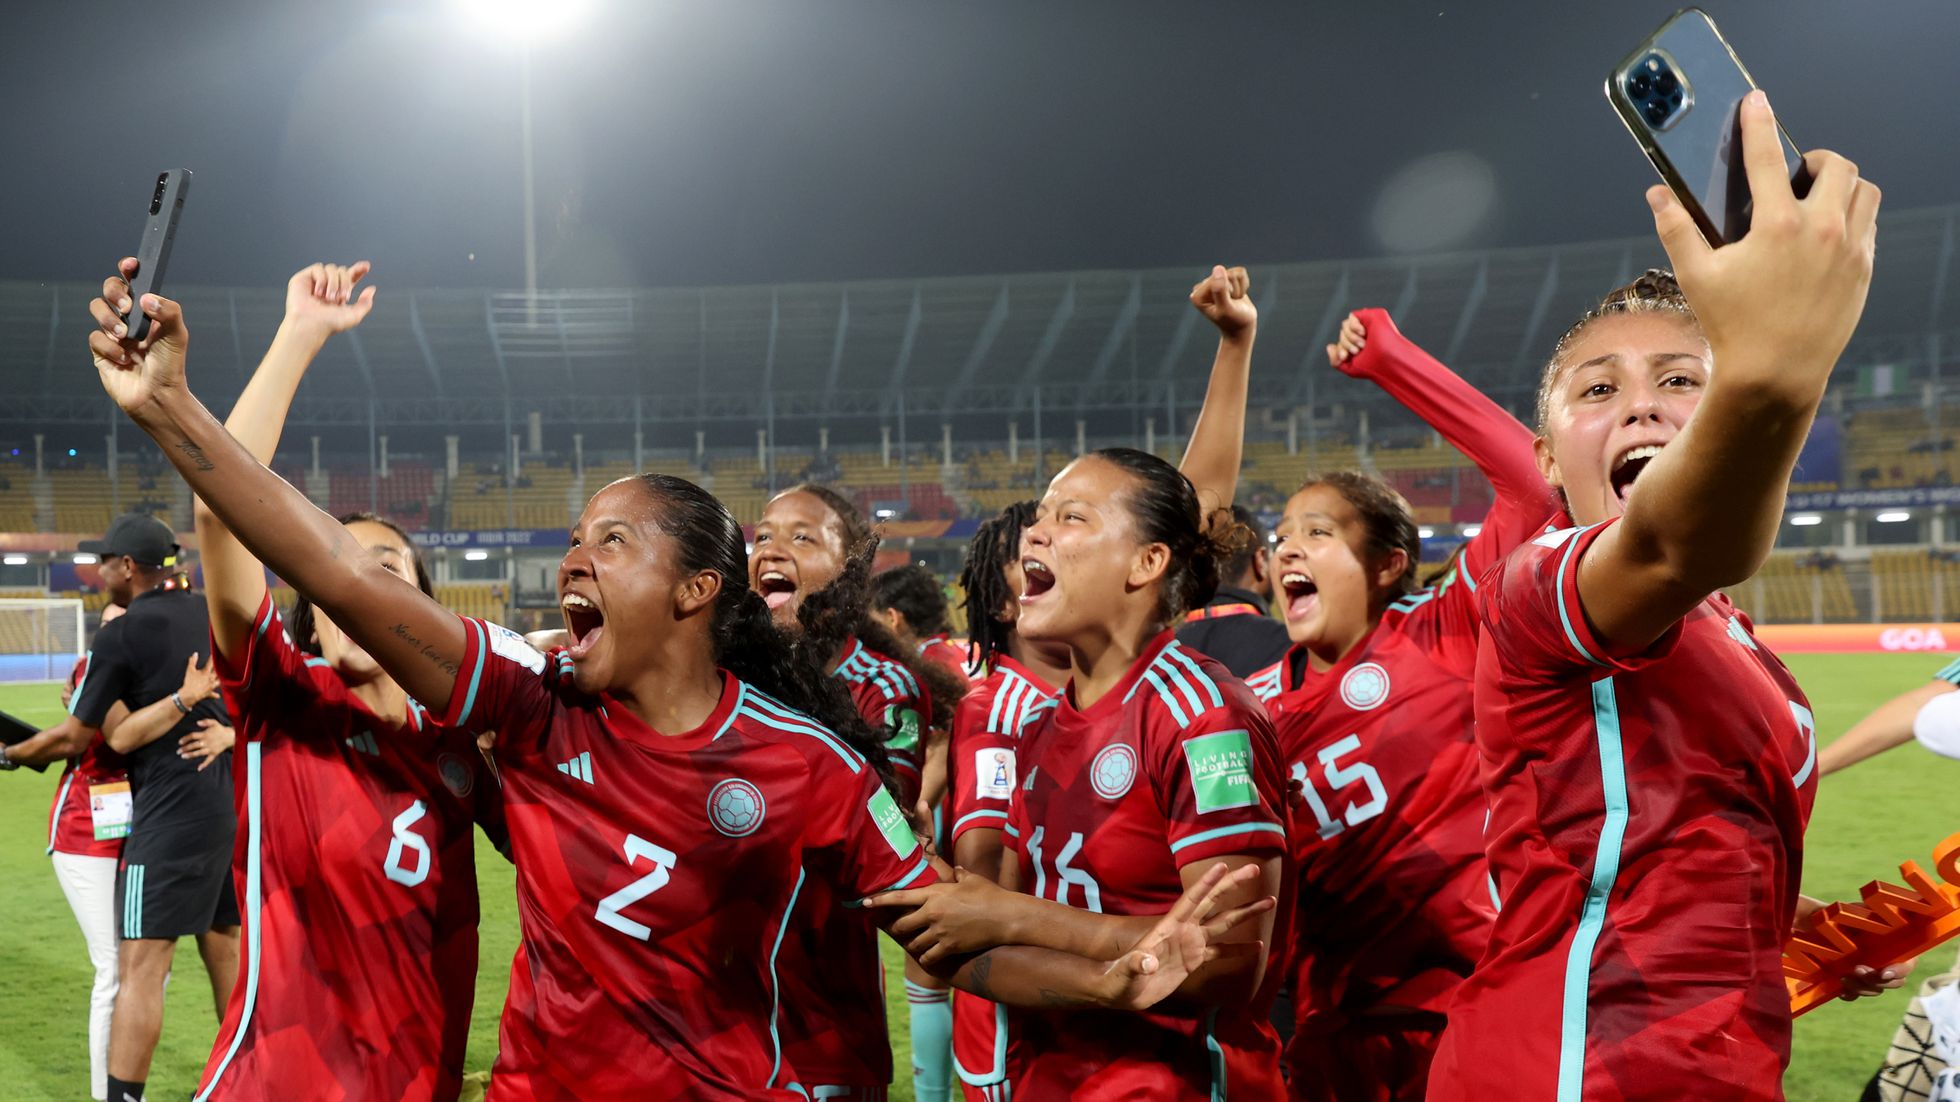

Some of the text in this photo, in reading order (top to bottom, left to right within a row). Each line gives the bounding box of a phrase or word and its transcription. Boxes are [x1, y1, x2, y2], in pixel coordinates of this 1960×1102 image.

[1194, 750, 1247, 768] LIVING
[1290, 732, 1389, 842] 15
[383, 799, 431, 887] 6
[594, 832, 677, 942] 2
[1026, 825, 1103, 914] 16
